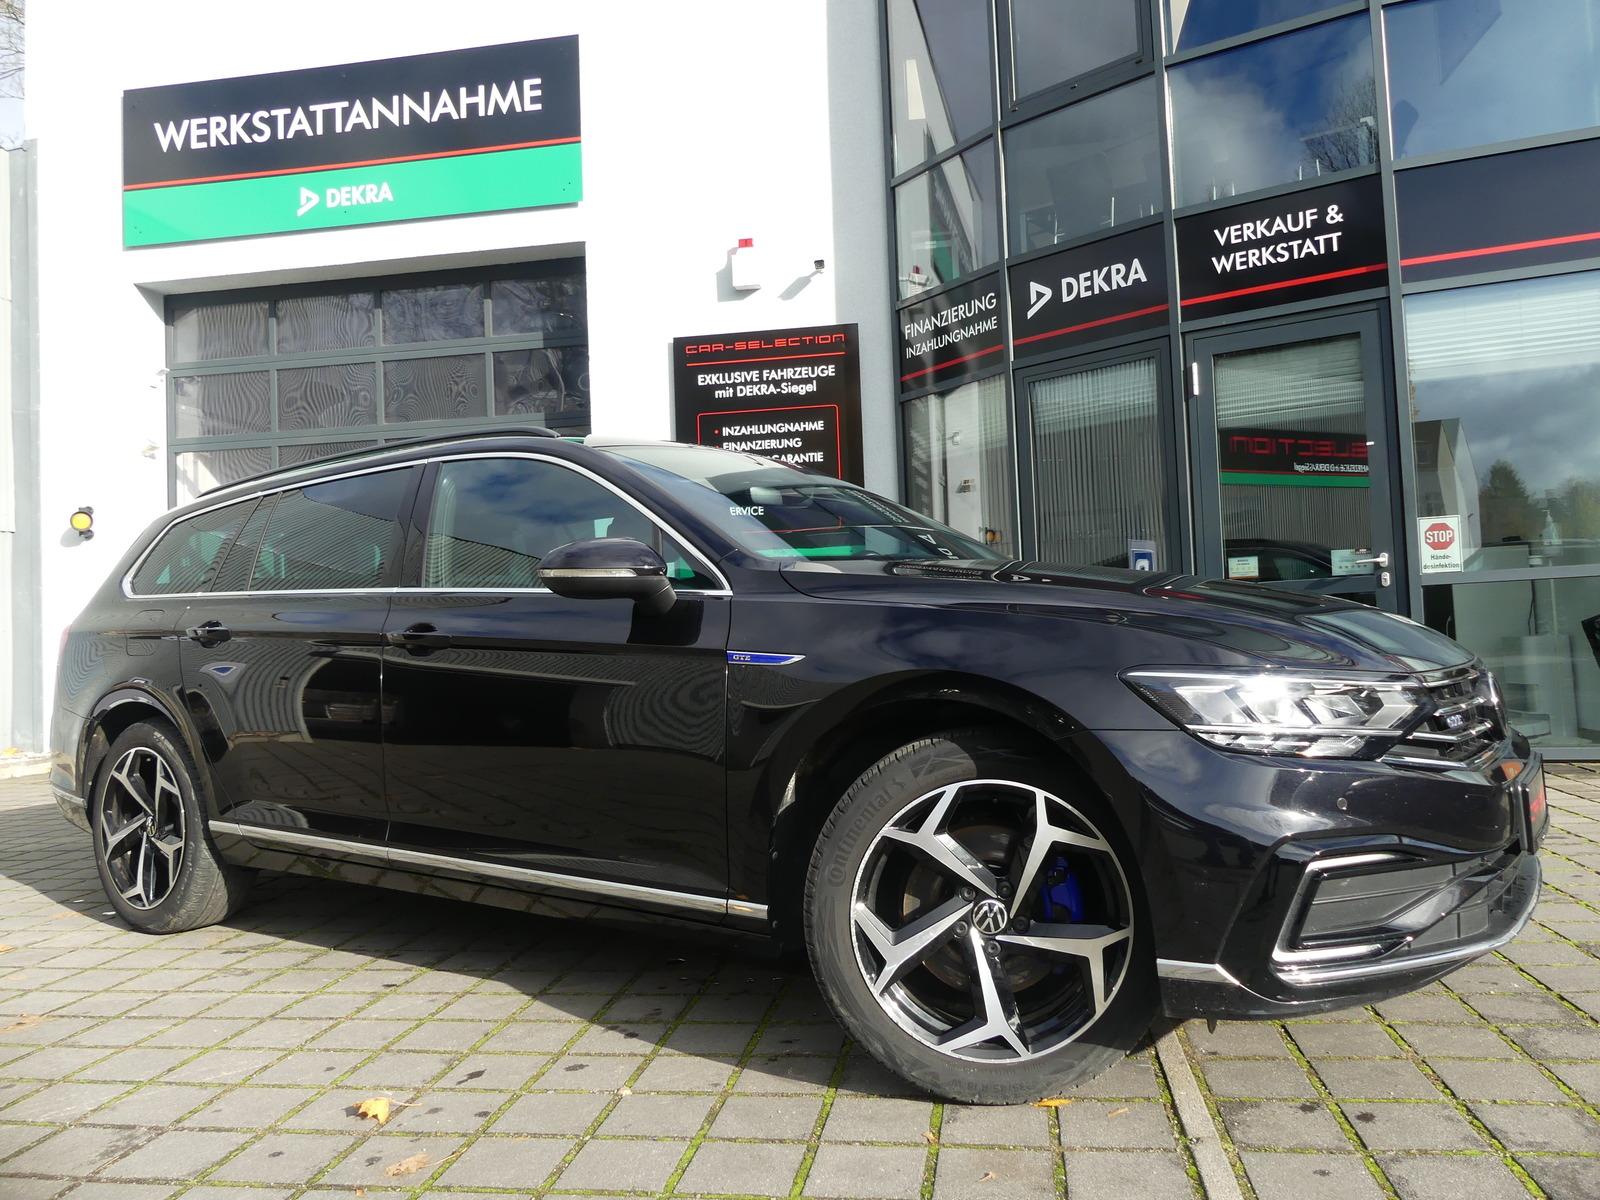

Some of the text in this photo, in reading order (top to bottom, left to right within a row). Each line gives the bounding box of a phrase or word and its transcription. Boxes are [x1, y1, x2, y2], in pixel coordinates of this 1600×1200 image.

[153, 77, 543, 153] WERKSTATTANNAHME
[325, 181, 394, 209] DEKRA
[1213, 204, 1344, 247] VERKAUF &
[1211, 231, 1342, 275] WERKSTATT
[1061, 257, 1148, 303] DEKRA
[904, 292, 997, 340] FINANZIERUNG
[685, 333, 845, 353] CAR-SELECTION
[905, 315, 998, 359] INZAHLUNGNAHME
[697, 364, 836, 386] EXKLUSIVE FAHRZEUGE
[714, 380, 817, 399] mit DEKRA-Siegel
[722, 420, 825, 437] INZAHLUNGNAHME
[722, 438, 803, 452] FINANZIERUNG
[1425, 529, 1454, 544] STOP
